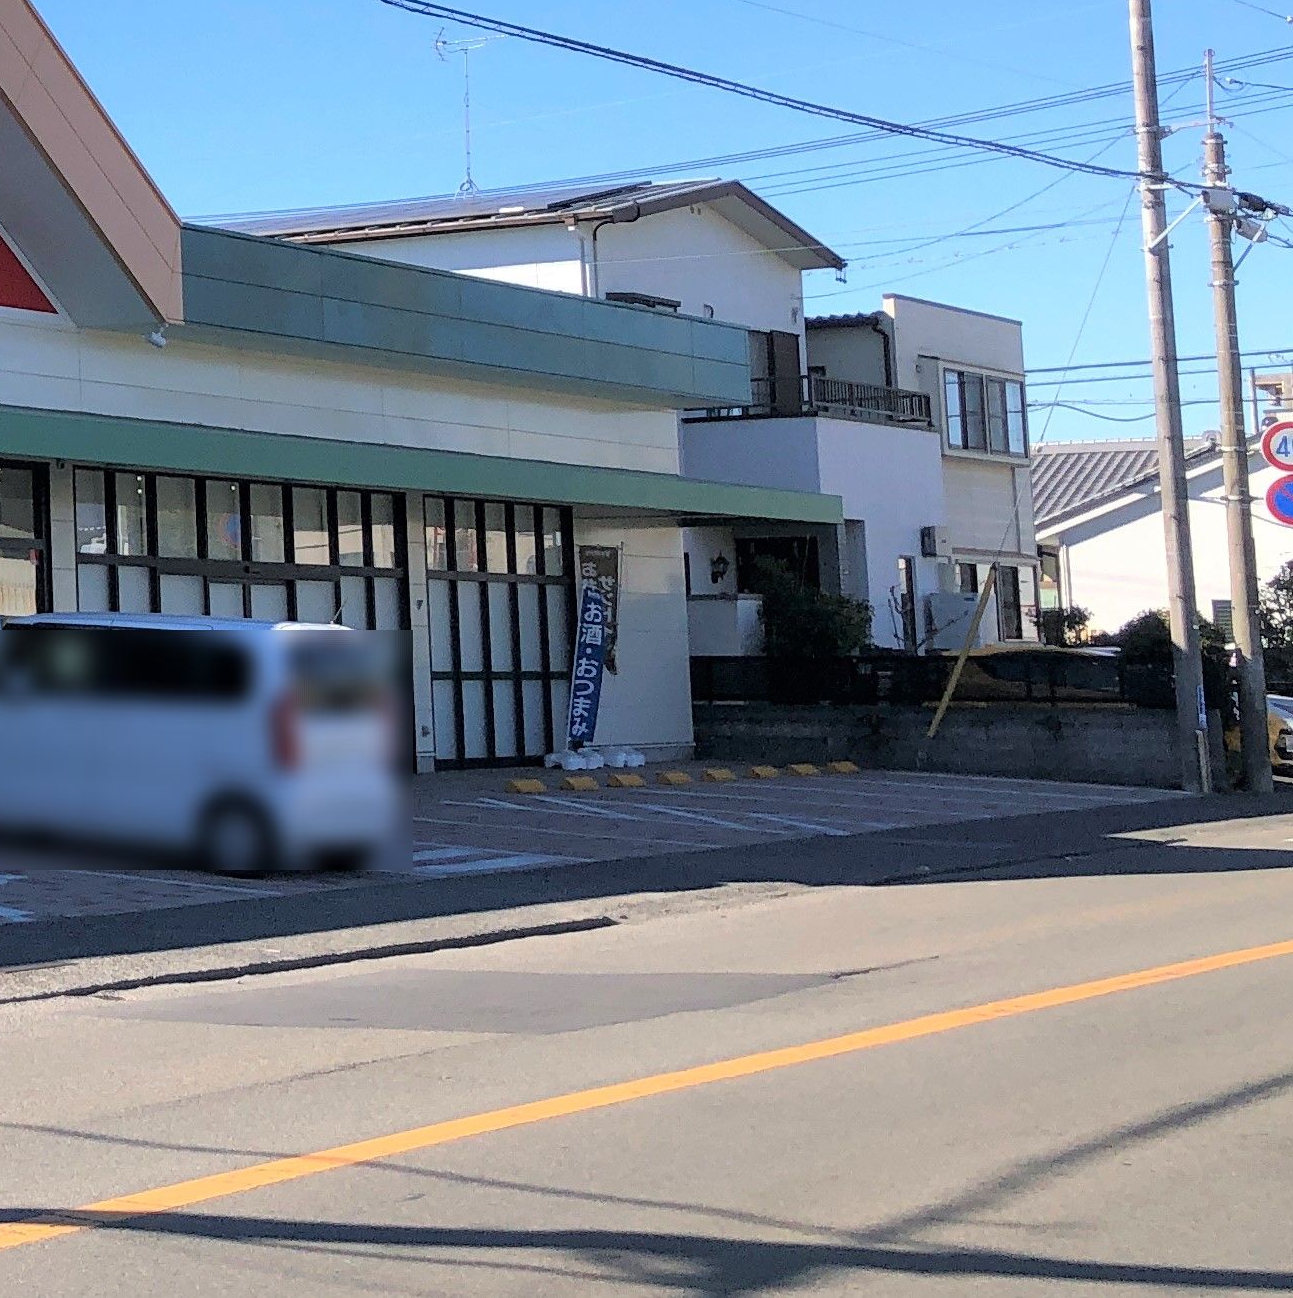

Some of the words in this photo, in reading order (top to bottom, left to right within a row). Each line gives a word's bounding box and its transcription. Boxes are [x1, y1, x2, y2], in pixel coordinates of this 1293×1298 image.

[1275, 435, 1293, 458] 4
[570, 601, 603, 737] お酒・おつまみ
